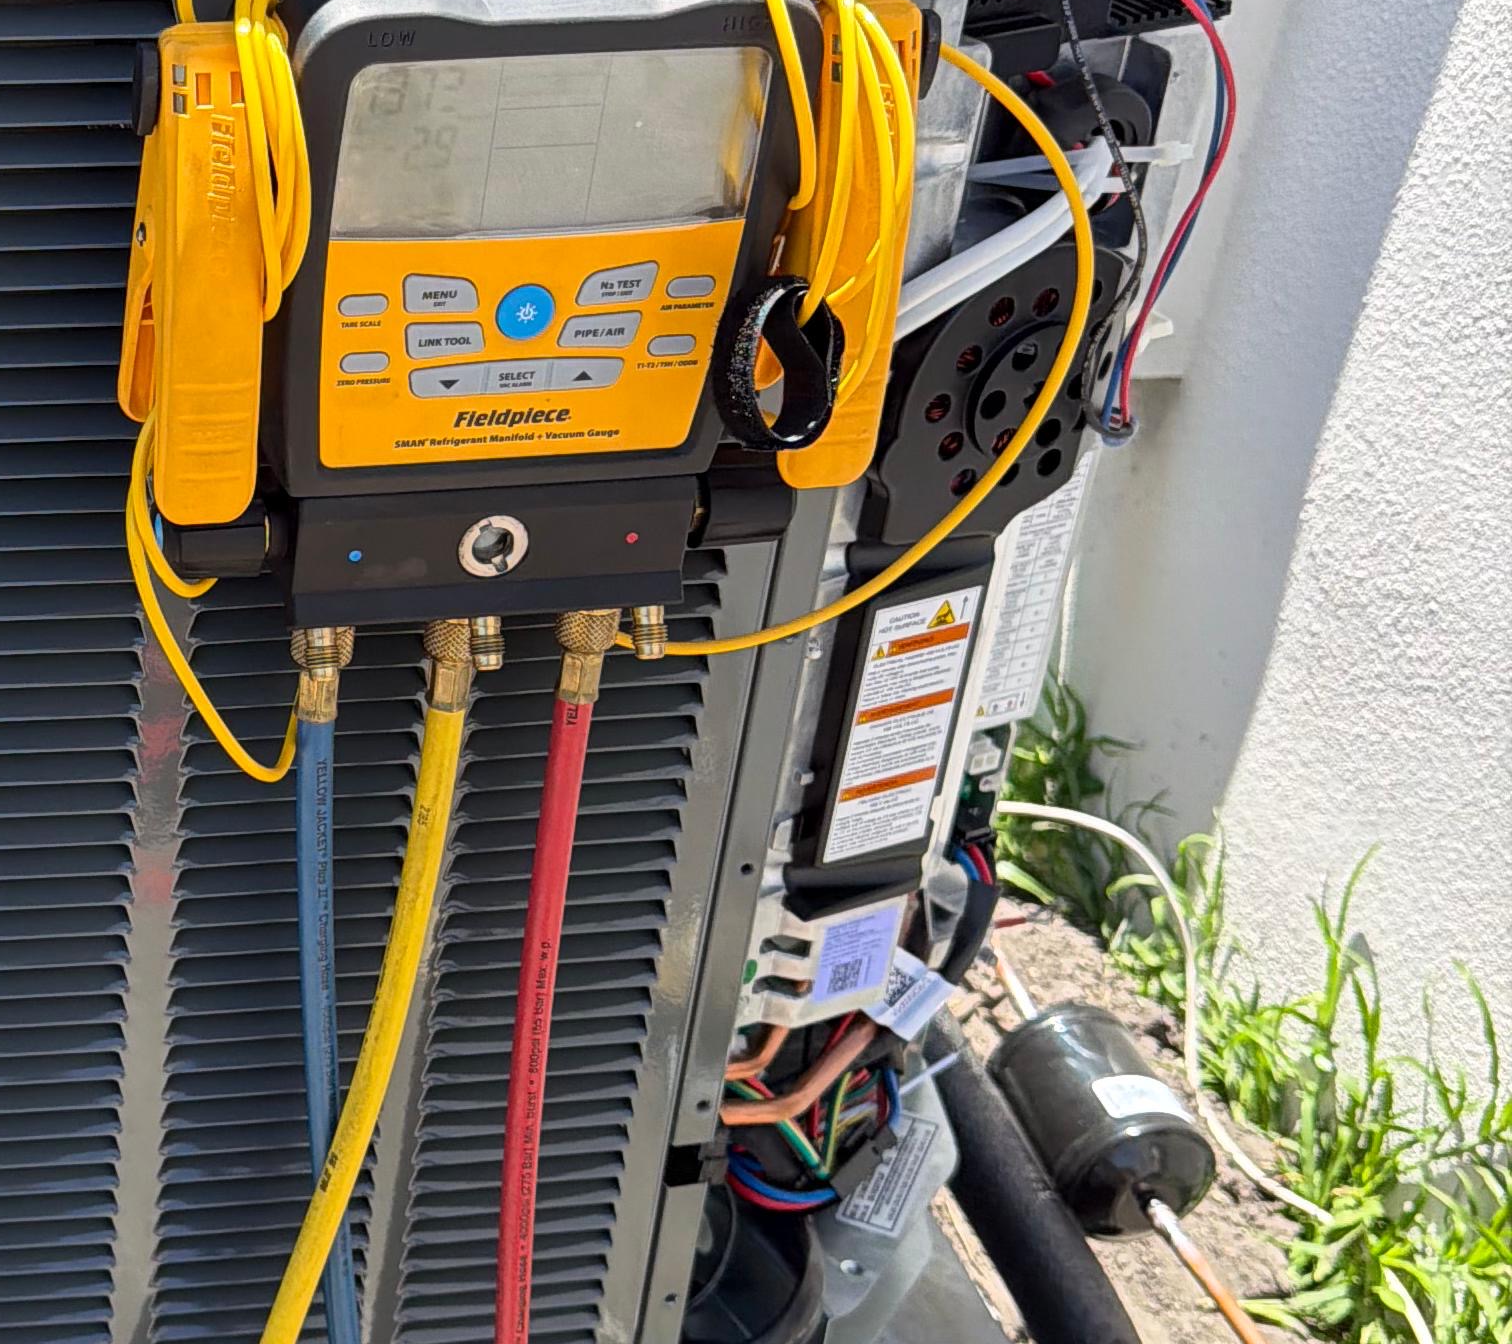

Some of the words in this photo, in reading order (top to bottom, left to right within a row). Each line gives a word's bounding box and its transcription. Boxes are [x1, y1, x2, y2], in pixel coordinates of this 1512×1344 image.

[367, 30, 417, 48] LOW
[617, 279, 642, 289] TEST
[421, 290, 458, 301] MENU
[673, 302, 715, 311] PARAMETER
[341, 321, 358, 329] TARE
[359, 320, 382, 328] SCALE
[418, 337, 444, 348] LINK
[445, 336, 472, 346] TOOL
[498, 370, 536, 381] SELECT
[336, 379, 355, 387] ZERO
[355, 377, 391, 386] PRESSURE
[429, 436, 487, 447] Refrigerant
[488, 432, 535, 443] Manifold
[544, 430, 585, 440] Vacuum
[587, 428, 620, 438] Gauge
[316, 758, 328, 806] YELLOW
[526, 1092, 536, 1119] burst
